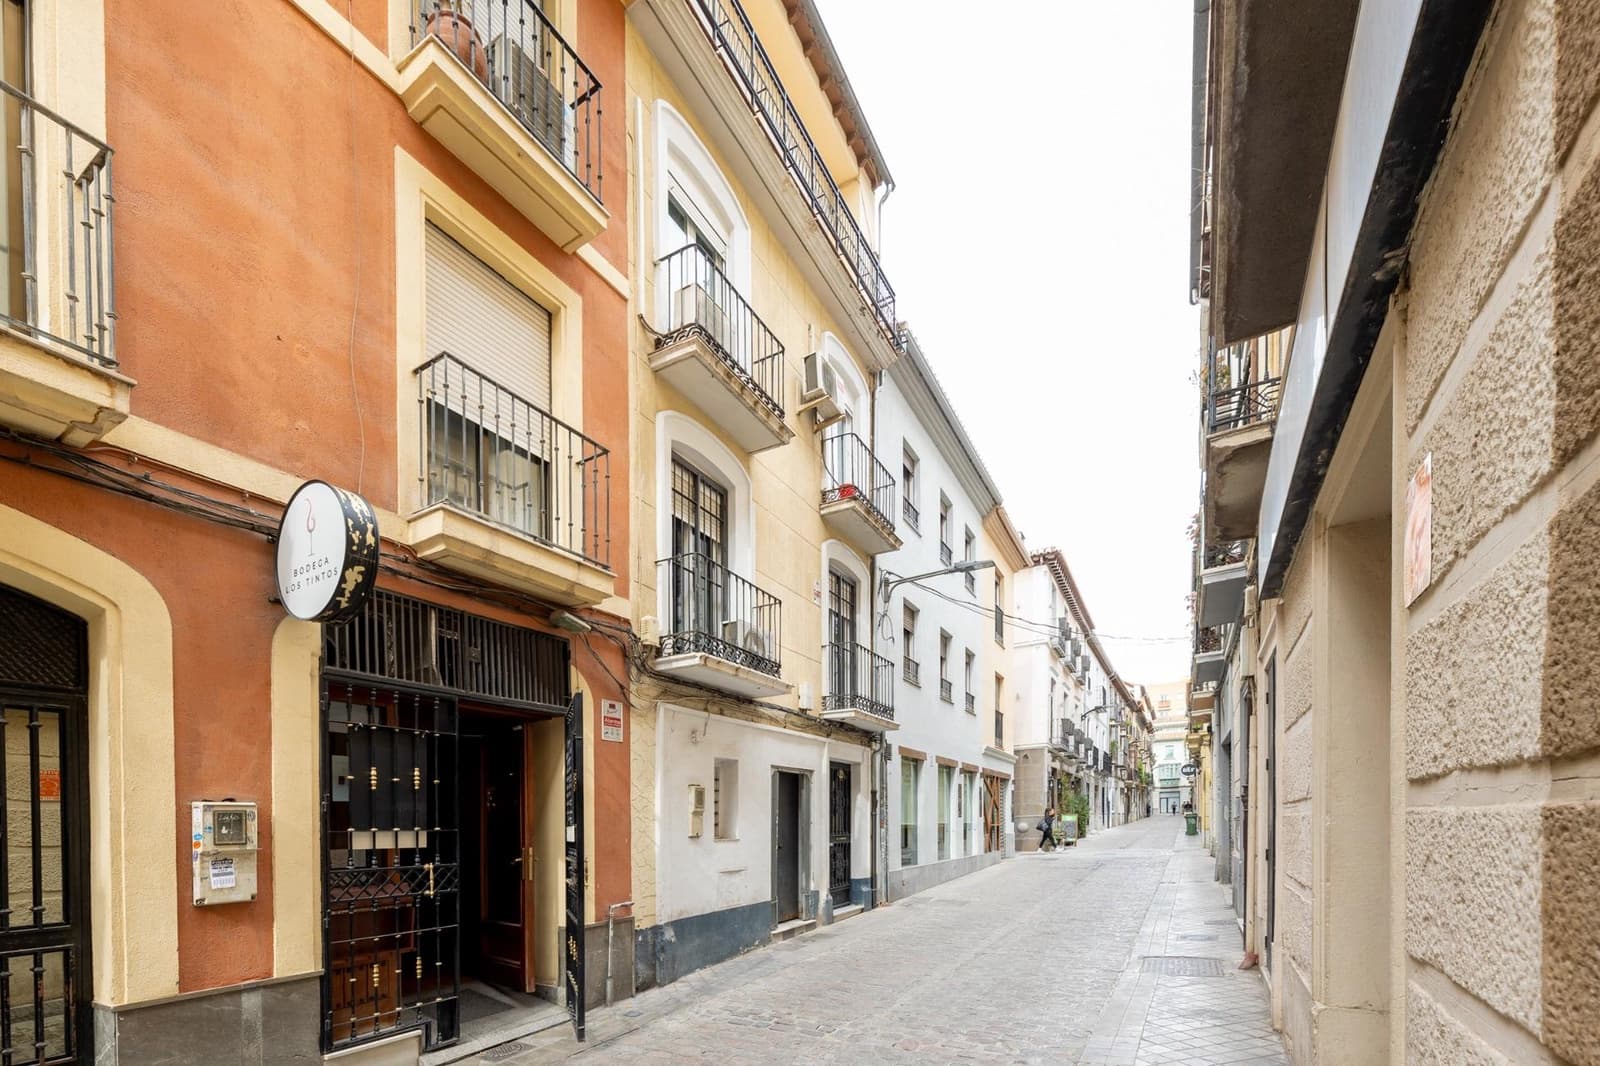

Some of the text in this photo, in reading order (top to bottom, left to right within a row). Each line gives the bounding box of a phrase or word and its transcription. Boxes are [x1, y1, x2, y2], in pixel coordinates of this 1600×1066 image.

[293, 556, 329, 578] BODEGA
[285, 567, 338, 594] LOS TINTOS
